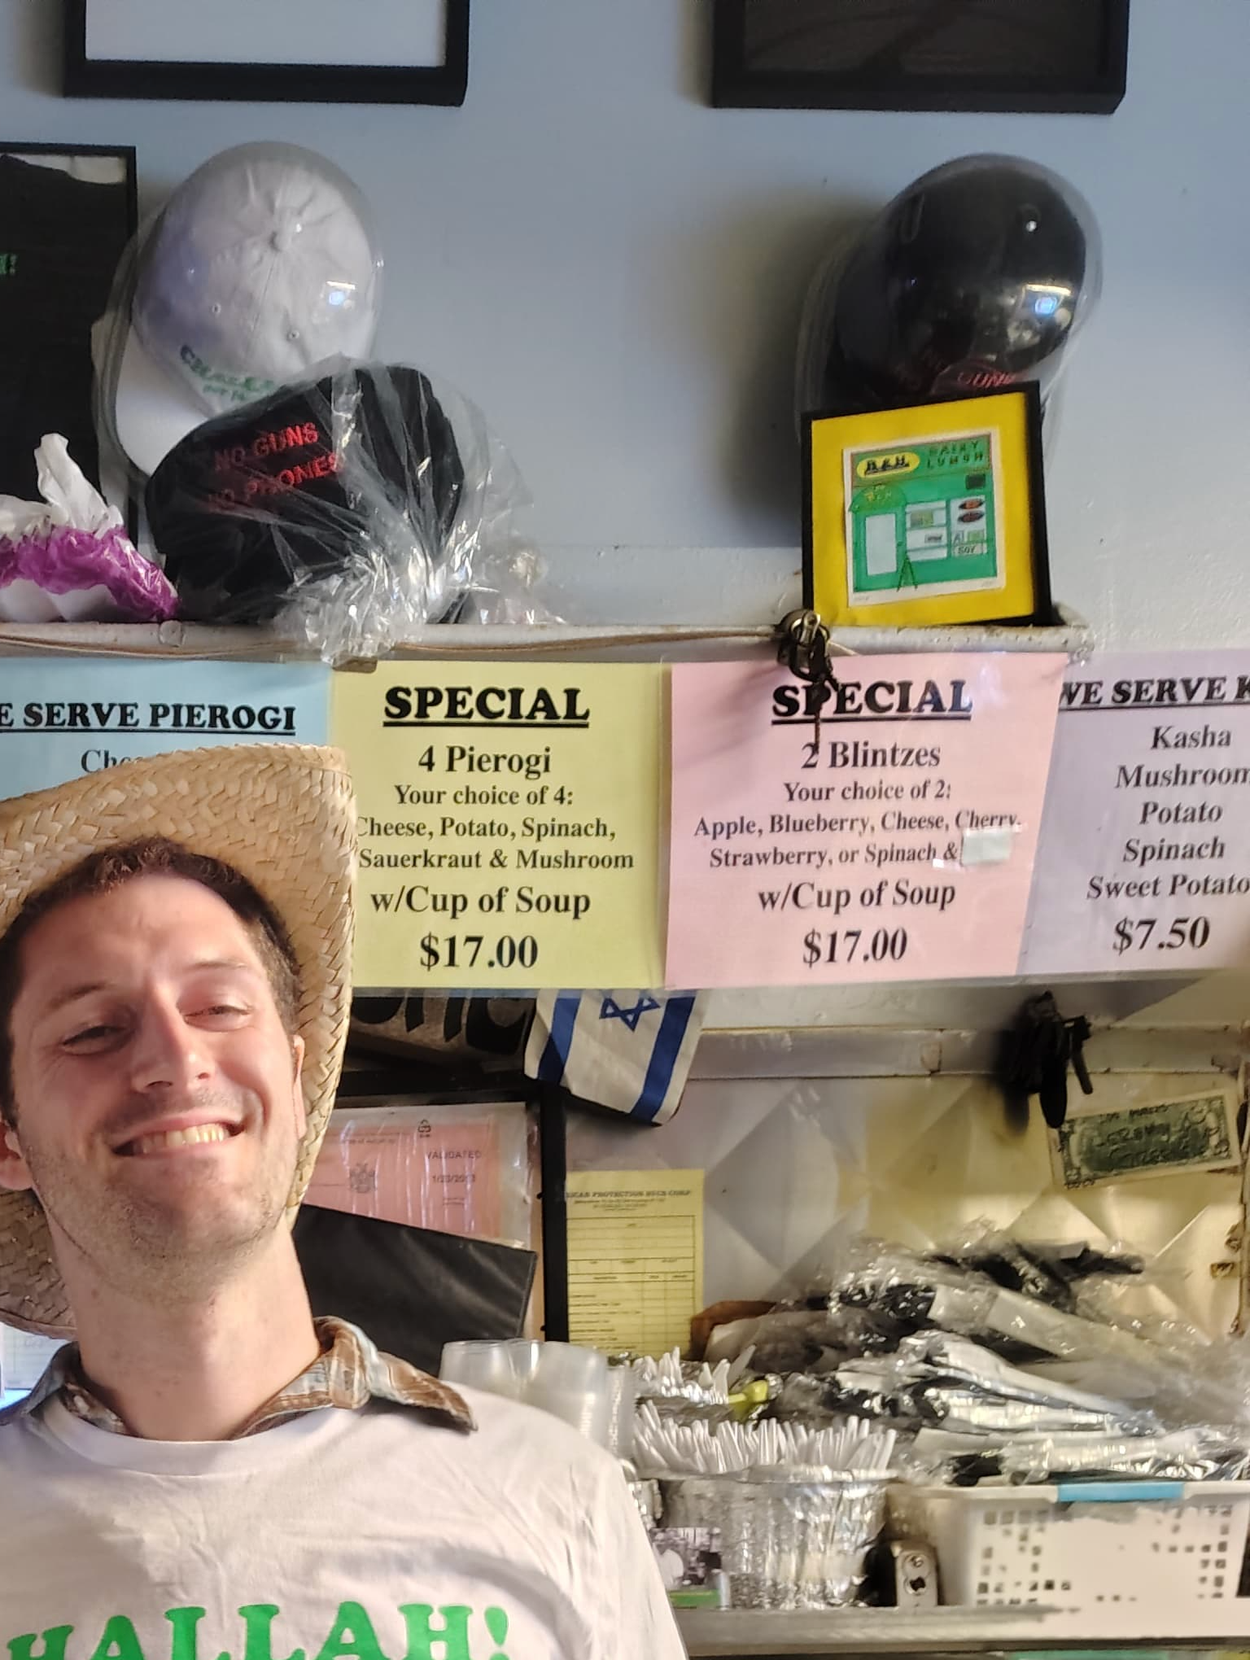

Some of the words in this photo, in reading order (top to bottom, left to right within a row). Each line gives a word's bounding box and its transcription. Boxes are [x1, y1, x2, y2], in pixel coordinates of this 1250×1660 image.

[253, 421, 319, 456] GUNS
[384, 686, 590, 720] SPECIAL
[773, 679, 973, 716] SPECIAL
[1111, 676, 1228, 705] SERVE
[23, 702, 140, 728] SERVE
[149, 702, 296, 730] PIEROGI
[1151, 724, 1232, 750] Kasha
[418, 745, 435, 772] 4
[446, 745, 552, 780] Pierogi
[801, 742, 819, 769] 2
[828, 740, 941, 769] Blintzes
[394, 785, 447, 805] Your
[452, 785, 520, 805] choice
[526, 785, 549, 805] of
[553, 785, 573, 806] 4:
[784, 781, 835, 802] Your
[841, 779, 904, 801] choice
[910, 778, 930, 800] of
[934, 779, 951, 800] 2:
[694, 816, 764, 840] Apple,
[769, 812, 875, 838] Blueberry,
[881, 810, 950, 834] Cheese,
[1140, 800, 1223, 825] Potato
[357, 816, 434, 841] Cheese,
[440, 816, 516, 841] Potato,
[521, 816, 616, 842] Spinach,
[358, 848, 482, 869] Sauerkraut
[489, 849, 508, 869] &
[516, 848, 634, 870] Mushroom
[710, 847, 833, 869] Strawberry,
[838, 849, 859, 864] or
[864, 842, 936, 867] Spinach
[943, 842, 958, 860] &
[1123, 836, 1226, 867] Spinach
[758, 881, 851, 915] w/Cup
[860, 880, 888, 907] of
[892, 878, 956, 911] Soup
[1087, 875, 1162, 900] Sweet
[1169, 873, 1250, 896] Potato
[370, 884, 468, 919] w/Cup
[478, 885, 509, 913] of
[515, 885, 591, 920] Soup
[803, 927, 907, 969] $17.00
[1113, 915, 1211, 956] $7.50
[419, 931, 538, 972] $17.00
